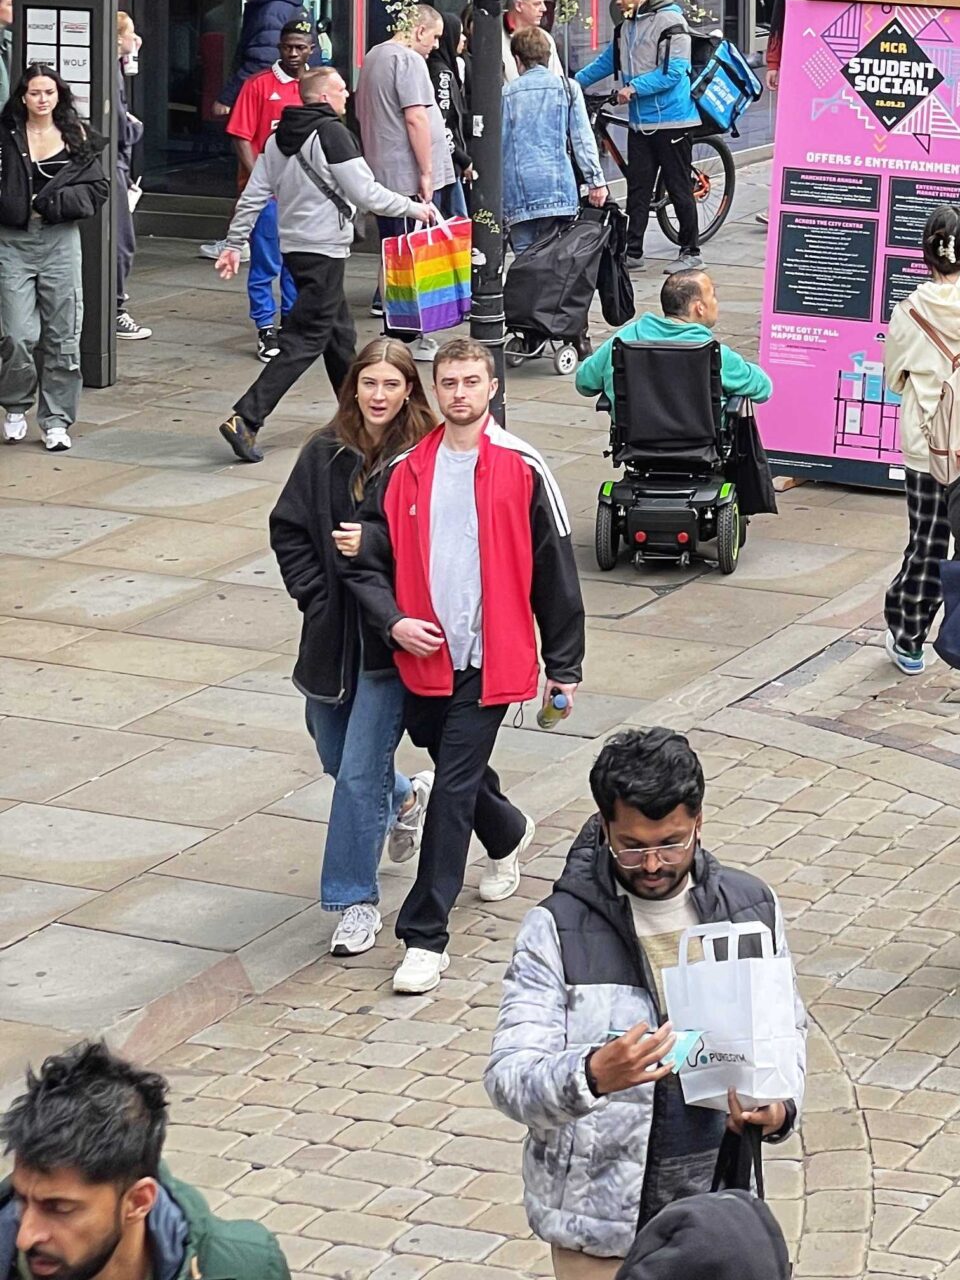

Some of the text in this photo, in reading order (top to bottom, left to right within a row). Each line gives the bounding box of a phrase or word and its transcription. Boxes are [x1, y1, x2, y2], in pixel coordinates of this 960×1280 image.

[880, 41, 908, 54] MCR
[63, 58, 87, 67] WOLF
[848, 57, 937, 80] STUDENT
[854, 75, 930, 97] SOCIAL
[806, 151, 852, 166] OFFERS
[853, 155, 863, 167] &
[794, 217, 816, 225] ACROSS
[770, 331, 802, 341] MAPPED
[796, 325, 812, 334] GOT
[813, 326, 823, 335] IT
[823, 328, 839, 337] ALL
